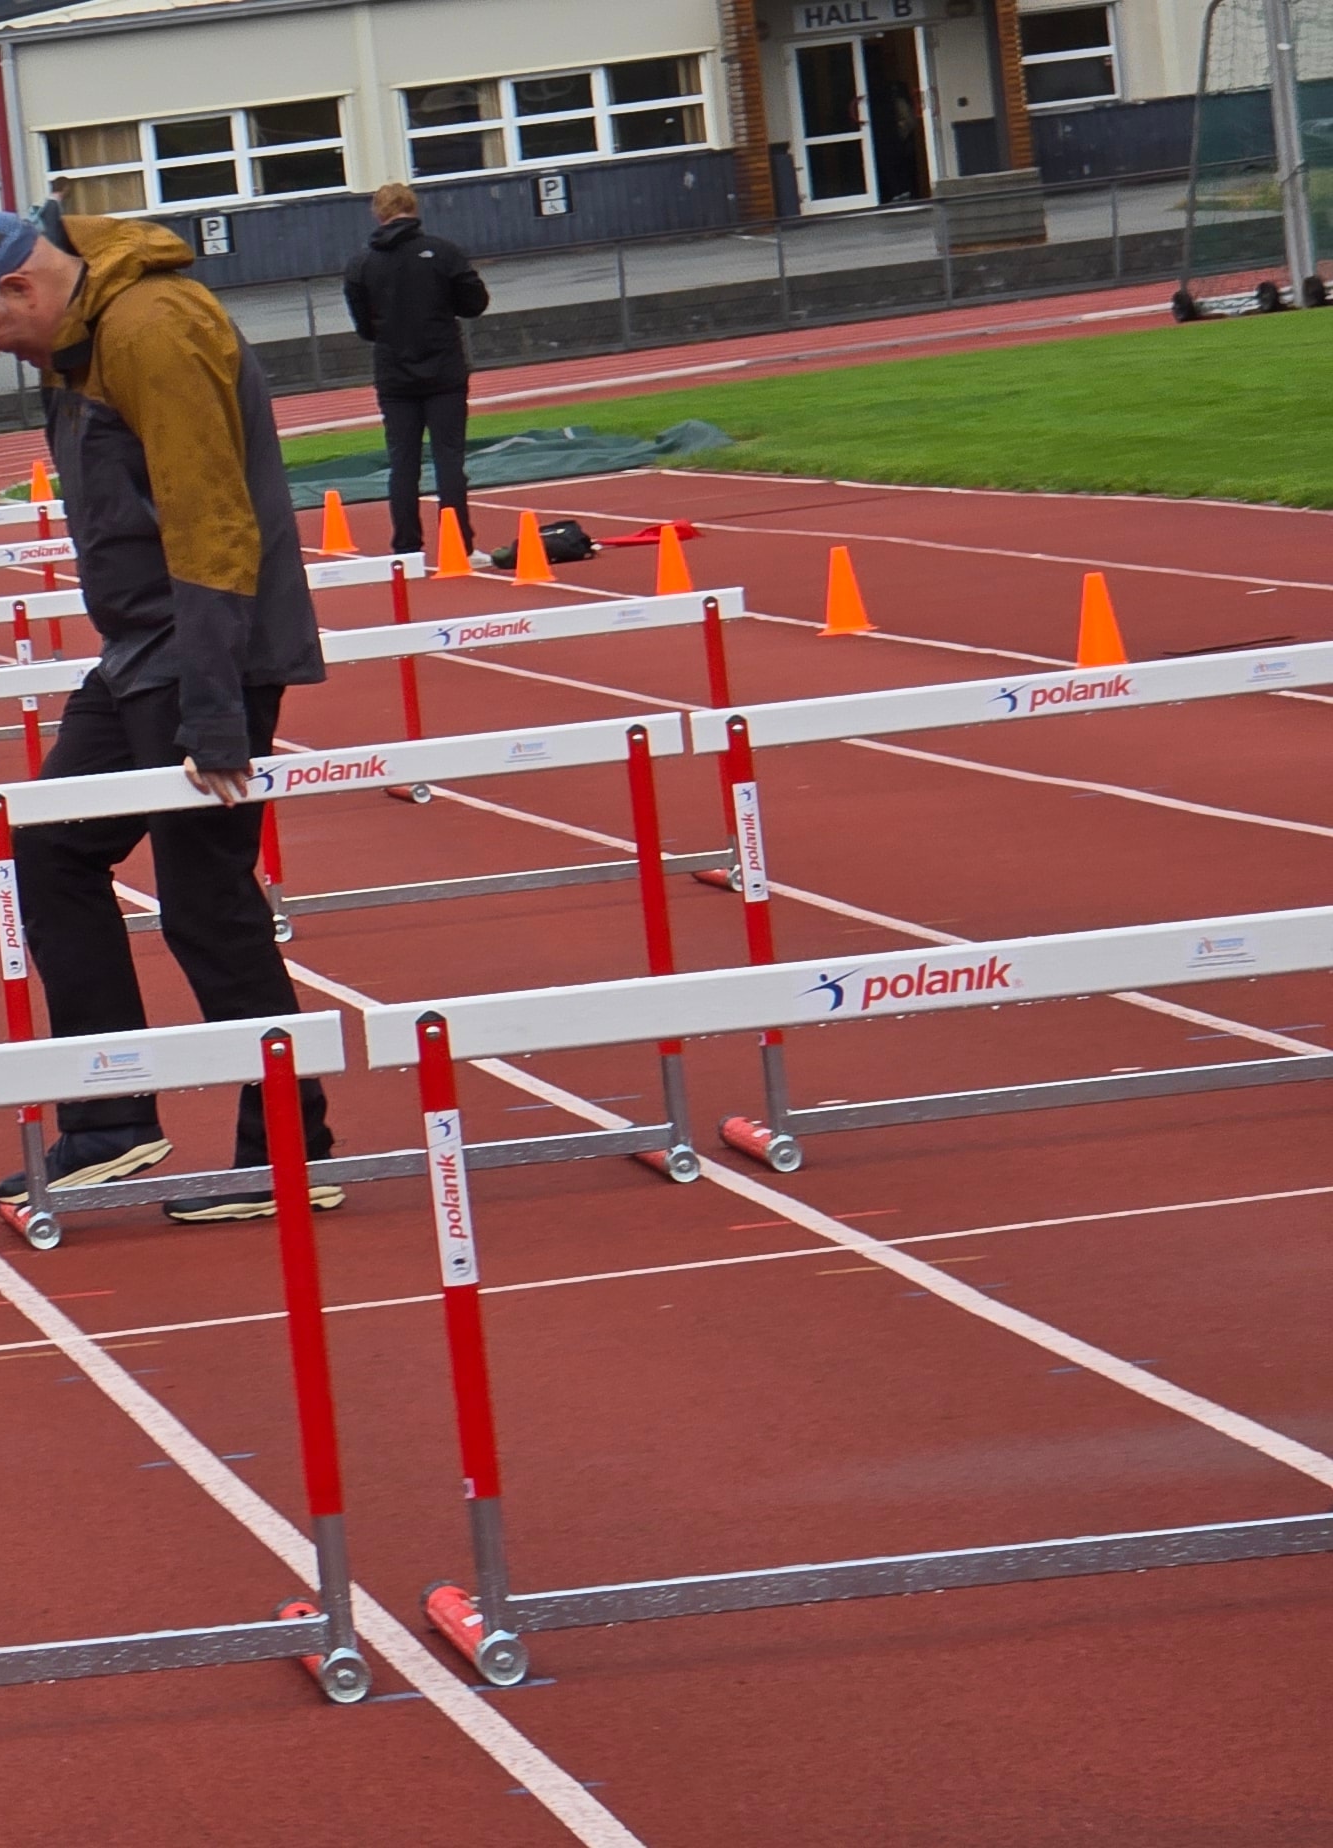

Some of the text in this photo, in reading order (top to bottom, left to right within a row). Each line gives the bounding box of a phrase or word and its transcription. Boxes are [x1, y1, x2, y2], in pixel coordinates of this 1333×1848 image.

[804, 0, 912, 28] HALL B
[545, 180, 559, 197] P
[206, 220, 221, 237] P
[458, 618, 532, 646] polanik
[1028, 673, 1131, 713] polanik
[286, 755, 388, 792] polanik
[742, 812, 763, 872] polanik
[860, 954, 1013, 1012] polanik
[436, 1152, 470, 1242] polanik
